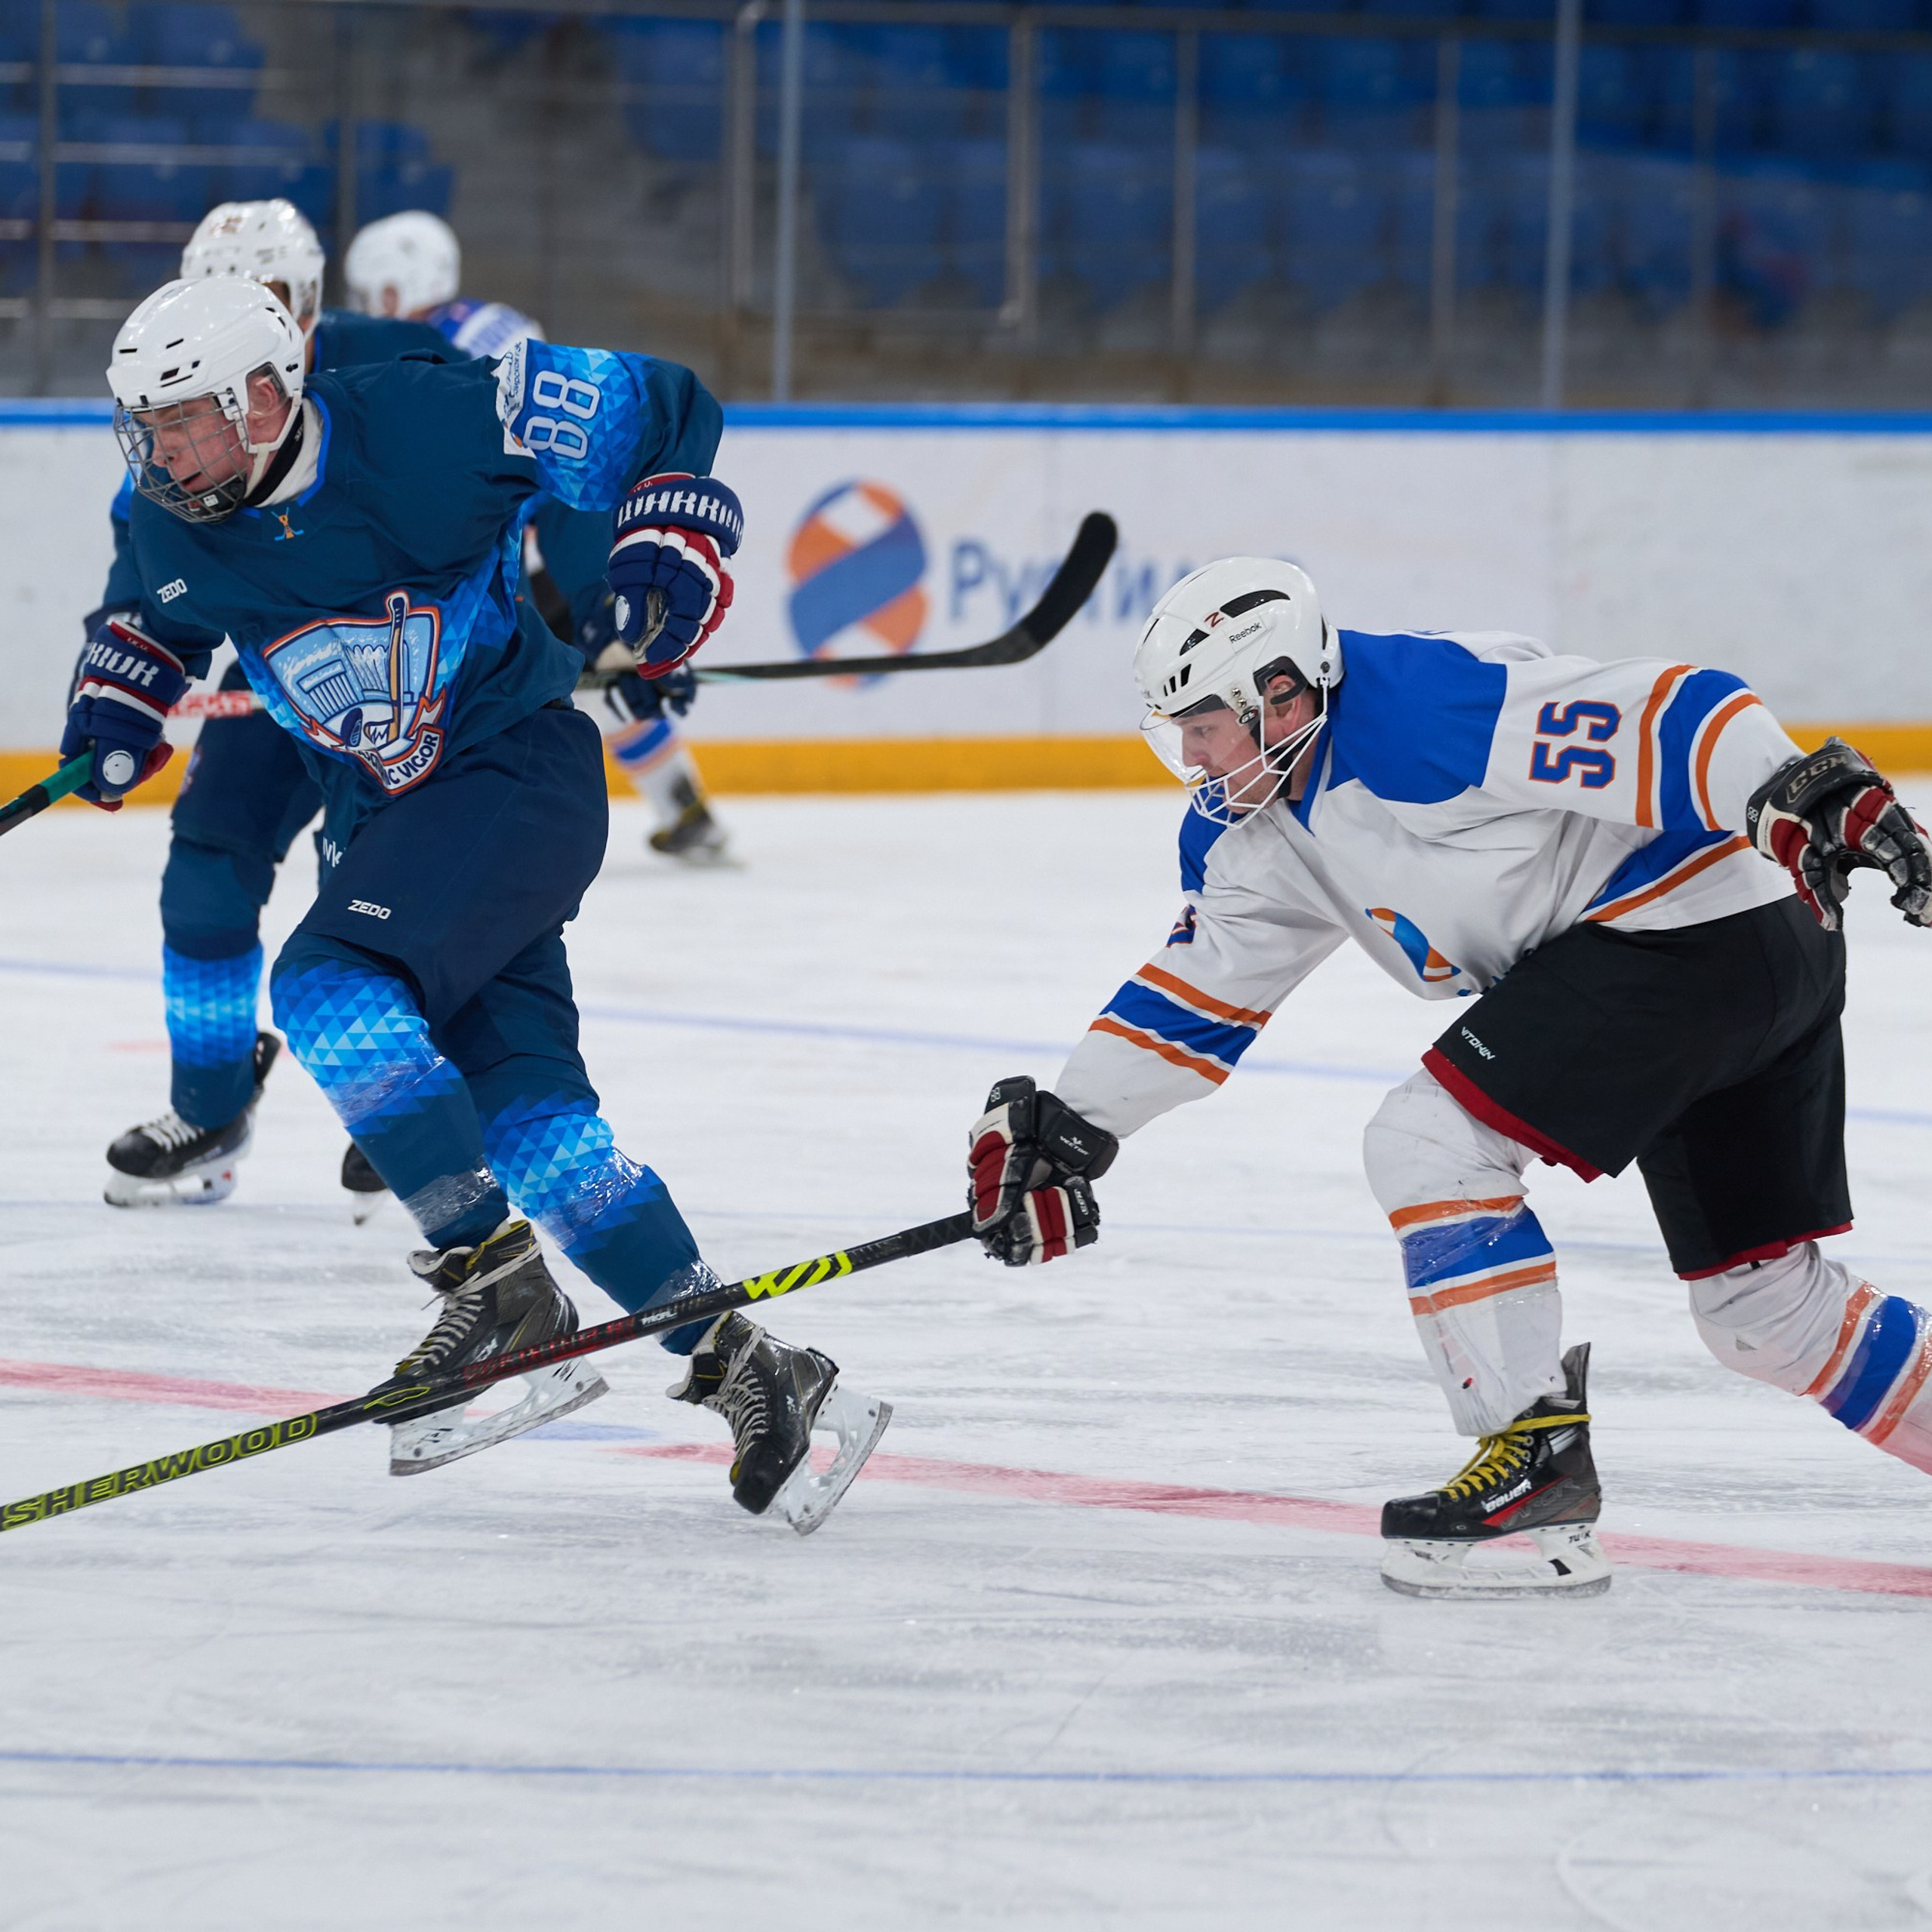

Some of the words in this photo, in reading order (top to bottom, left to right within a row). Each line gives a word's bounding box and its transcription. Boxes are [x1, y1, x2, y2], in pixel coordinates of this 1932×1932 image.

[522, 370, 601, 460] 88
[156, 578, 188, 604] ZEDO
[1229, 622, 1263, 644] Reebok
[396, 734, 438, 778] VIGOR
[1528, 699, 1623, 789] 55
[1788, 754, 1847, 795] CCM
[348, 900, 391, 920] ZEDO
[1060, 1135, 1090, 1156] VECTOR
[2, 1413, 318, 1531] SHERWOOD
[1481, 1478, 1533, 1513] BAUER
